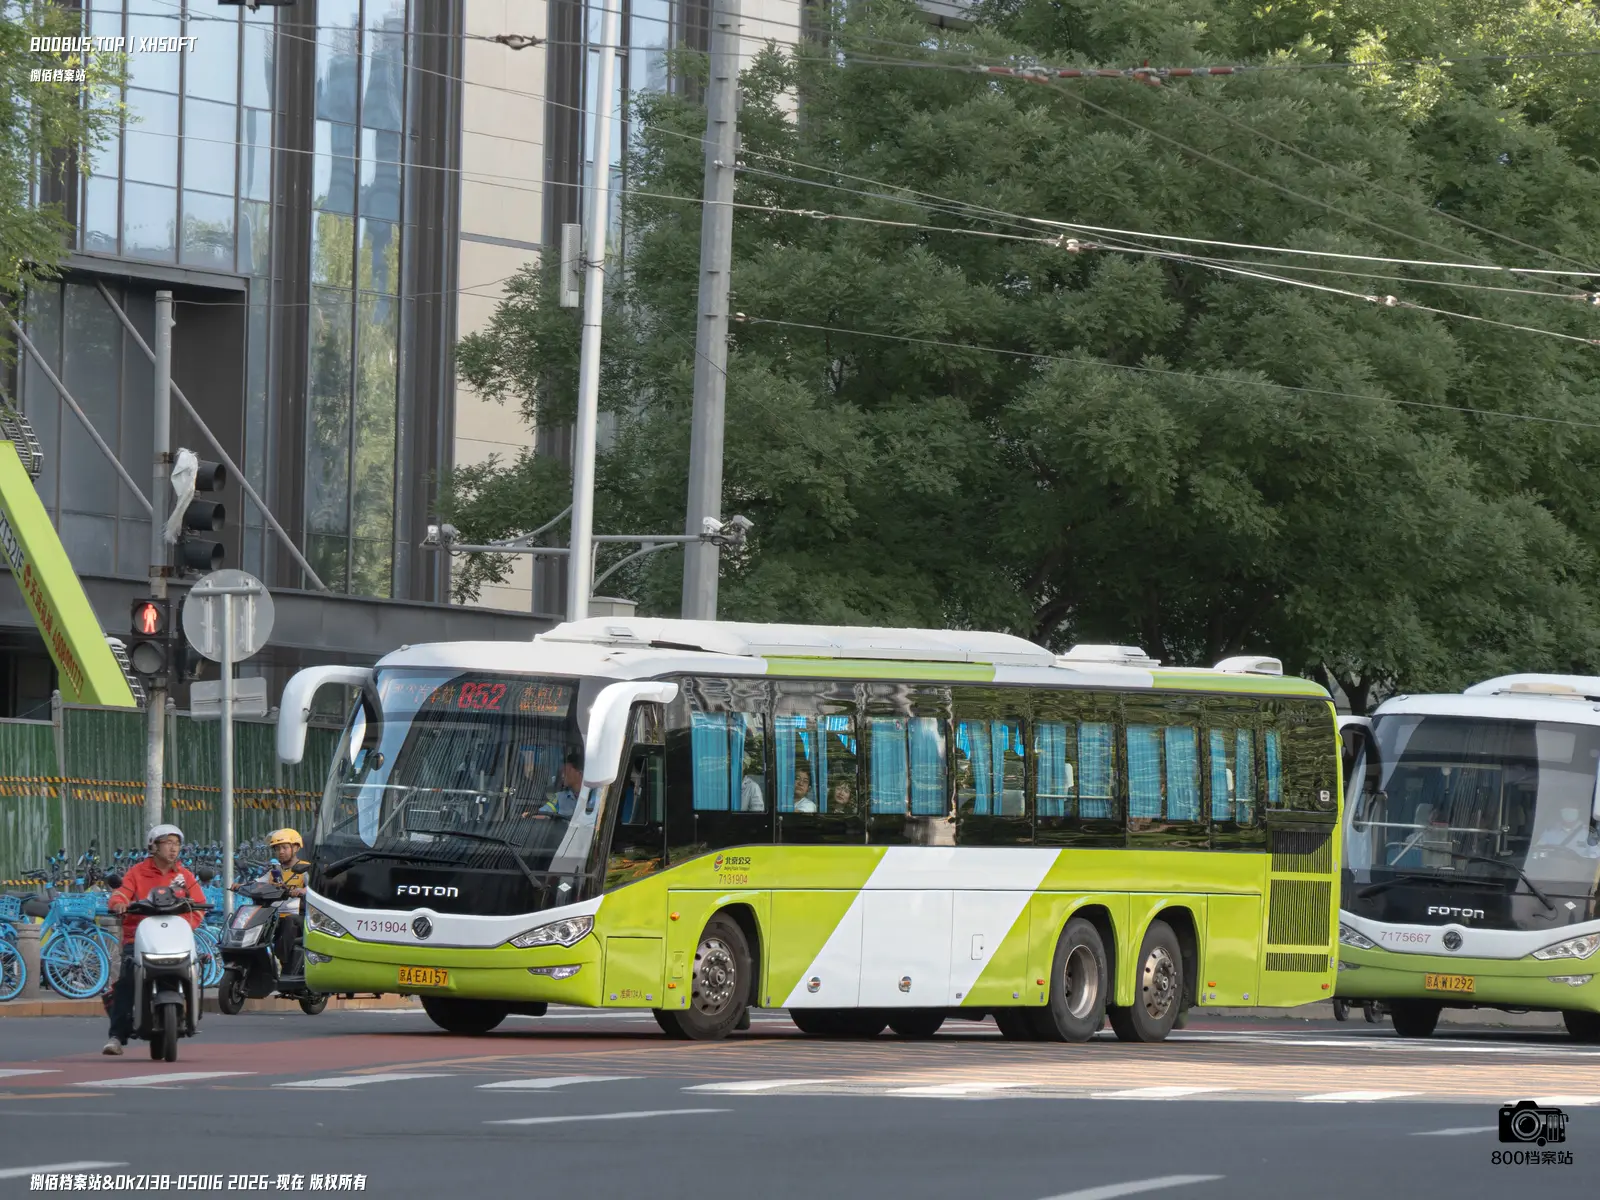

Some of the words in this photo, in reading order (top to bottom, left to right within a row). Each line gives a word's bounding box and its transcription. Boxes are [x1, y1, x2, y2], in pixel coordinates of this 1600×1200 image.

[458, 682, 507, 710] 852
[725, 856, 751, 864] 北京公交
[719, 873, 747, 884] 7131904
[397, 885, 459, 897] FOTON
[1428, 906, 1485, 919] FOTON
[357, 920, 407, 933] 7131904
[1380, 931, 1431, 943] 7175667
